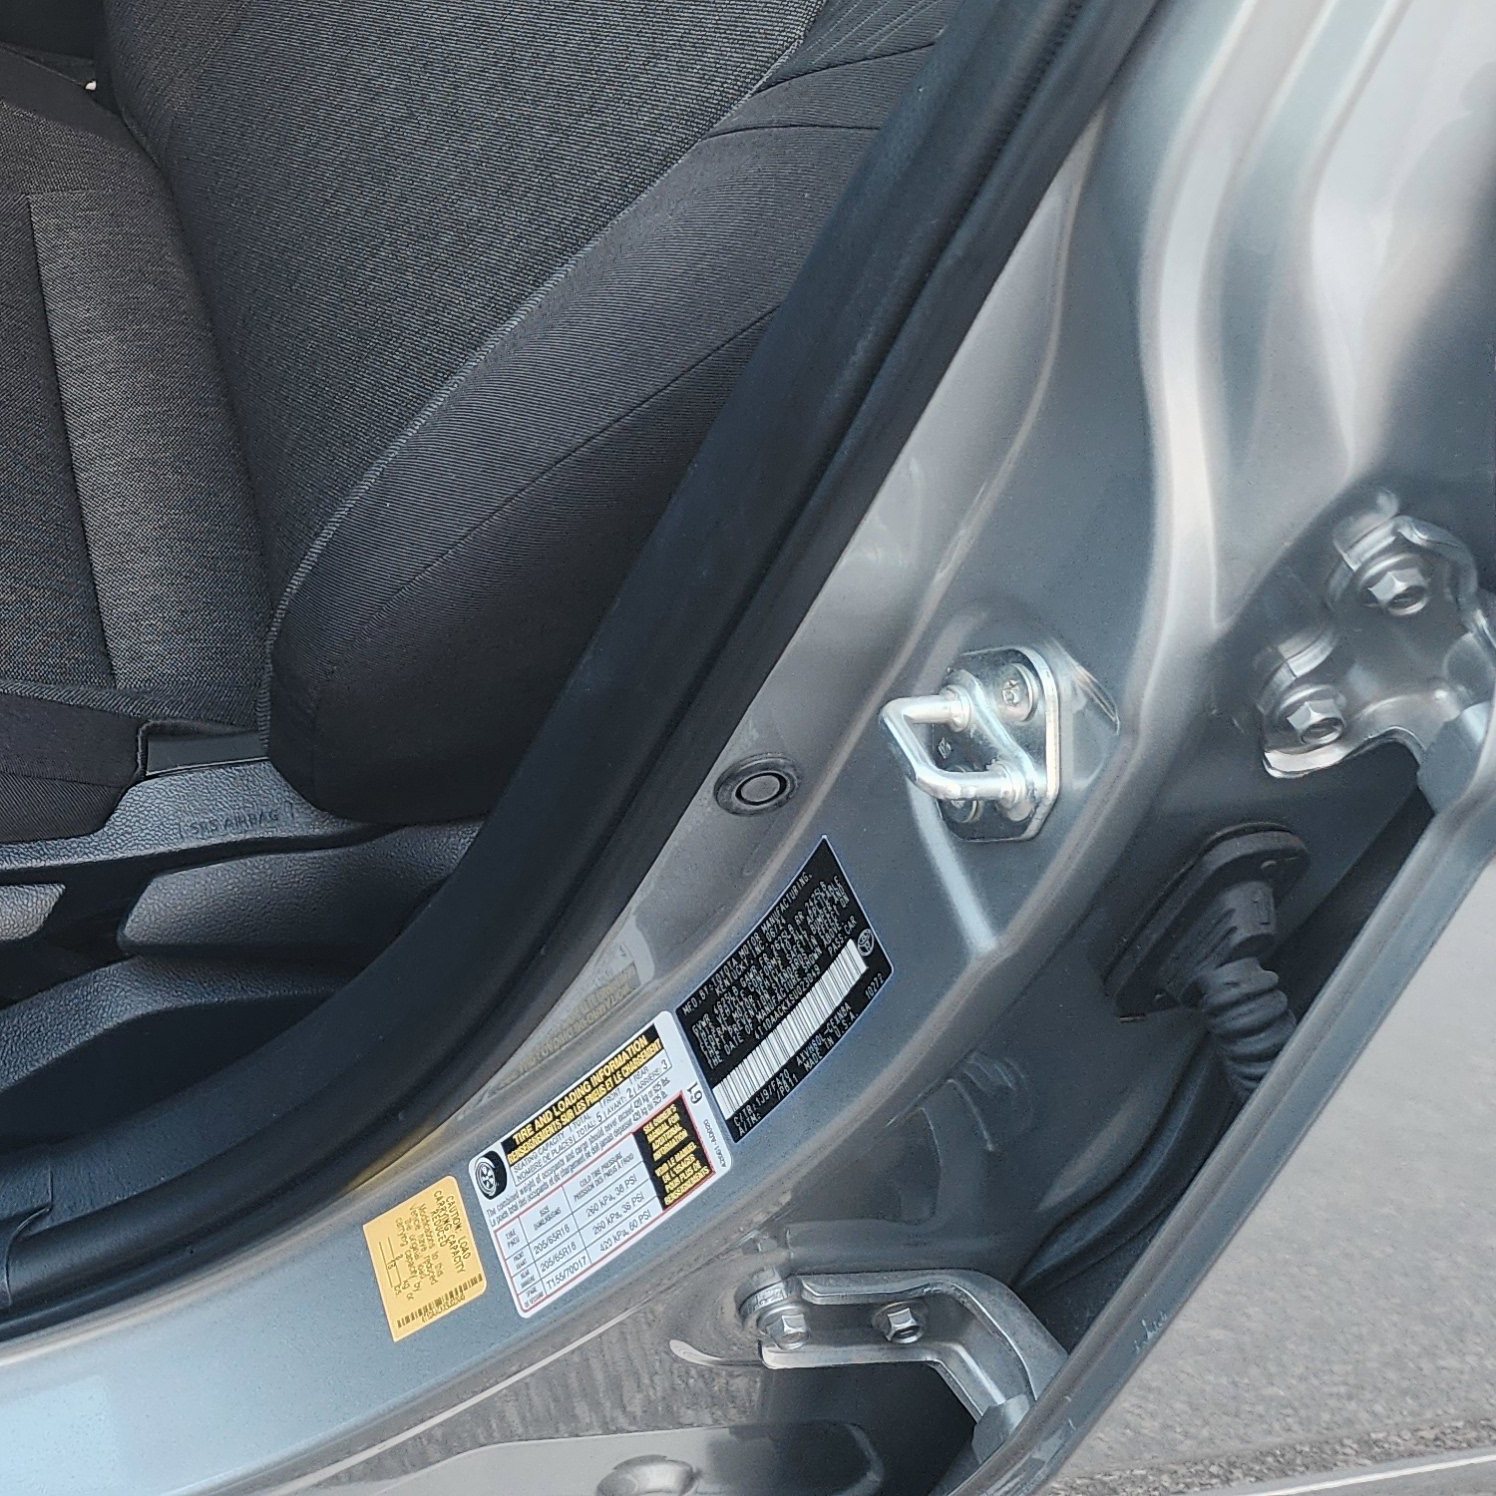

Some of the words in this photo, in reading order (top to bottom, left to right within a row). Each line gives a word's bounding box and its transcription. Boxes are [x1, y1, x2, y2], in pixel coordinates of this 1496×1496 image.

[737, 930, 761, 960] MOTOR
[690, 1011, 711, 1036] GVWR
[757, 950, 770, 968] FR
[722, 1031, 744, 1056] DATE
[743, 1019, 755, 1036] OF
[802, 1047, 823, 1073] MADE
[823, 1034, 835, 1051] IN
[511, 1122, 535, 1147] TIRE
[531, 1107, 555, 1133] AND
[551, 1077, 592, 1118] LOADING
[588, 1032, 649, 1088] INFORMATION
[558, 1106, 575, 1127] SUR
[571, 1097, 587, 1117] LES
[603, 1075, 615, 1092] ET
[611, 1068, 624, 1086] LE
[594, 1109, 604, 1124] 5
[624, 1085, 634, 1100] 2
[659, 1057, 669, 1071] 3
[685, 1080, 704, 1106] 61
[571, 1109, 592, 1130] TOTAL
[622, 1172, 638, 1190] PSI
[629, 1189, 645, 1207] PSI
[429, 1207, 448, 1248] REDUCED
[432, 1188, 453, 1233] CARRYING
[445, 1232, 466, 1275] CAPACITY
[627, 1216, 640, 1232] 60
[636, 1207, 652, 1225] PSI
[456, 1235, 472, 1261] LOAD
